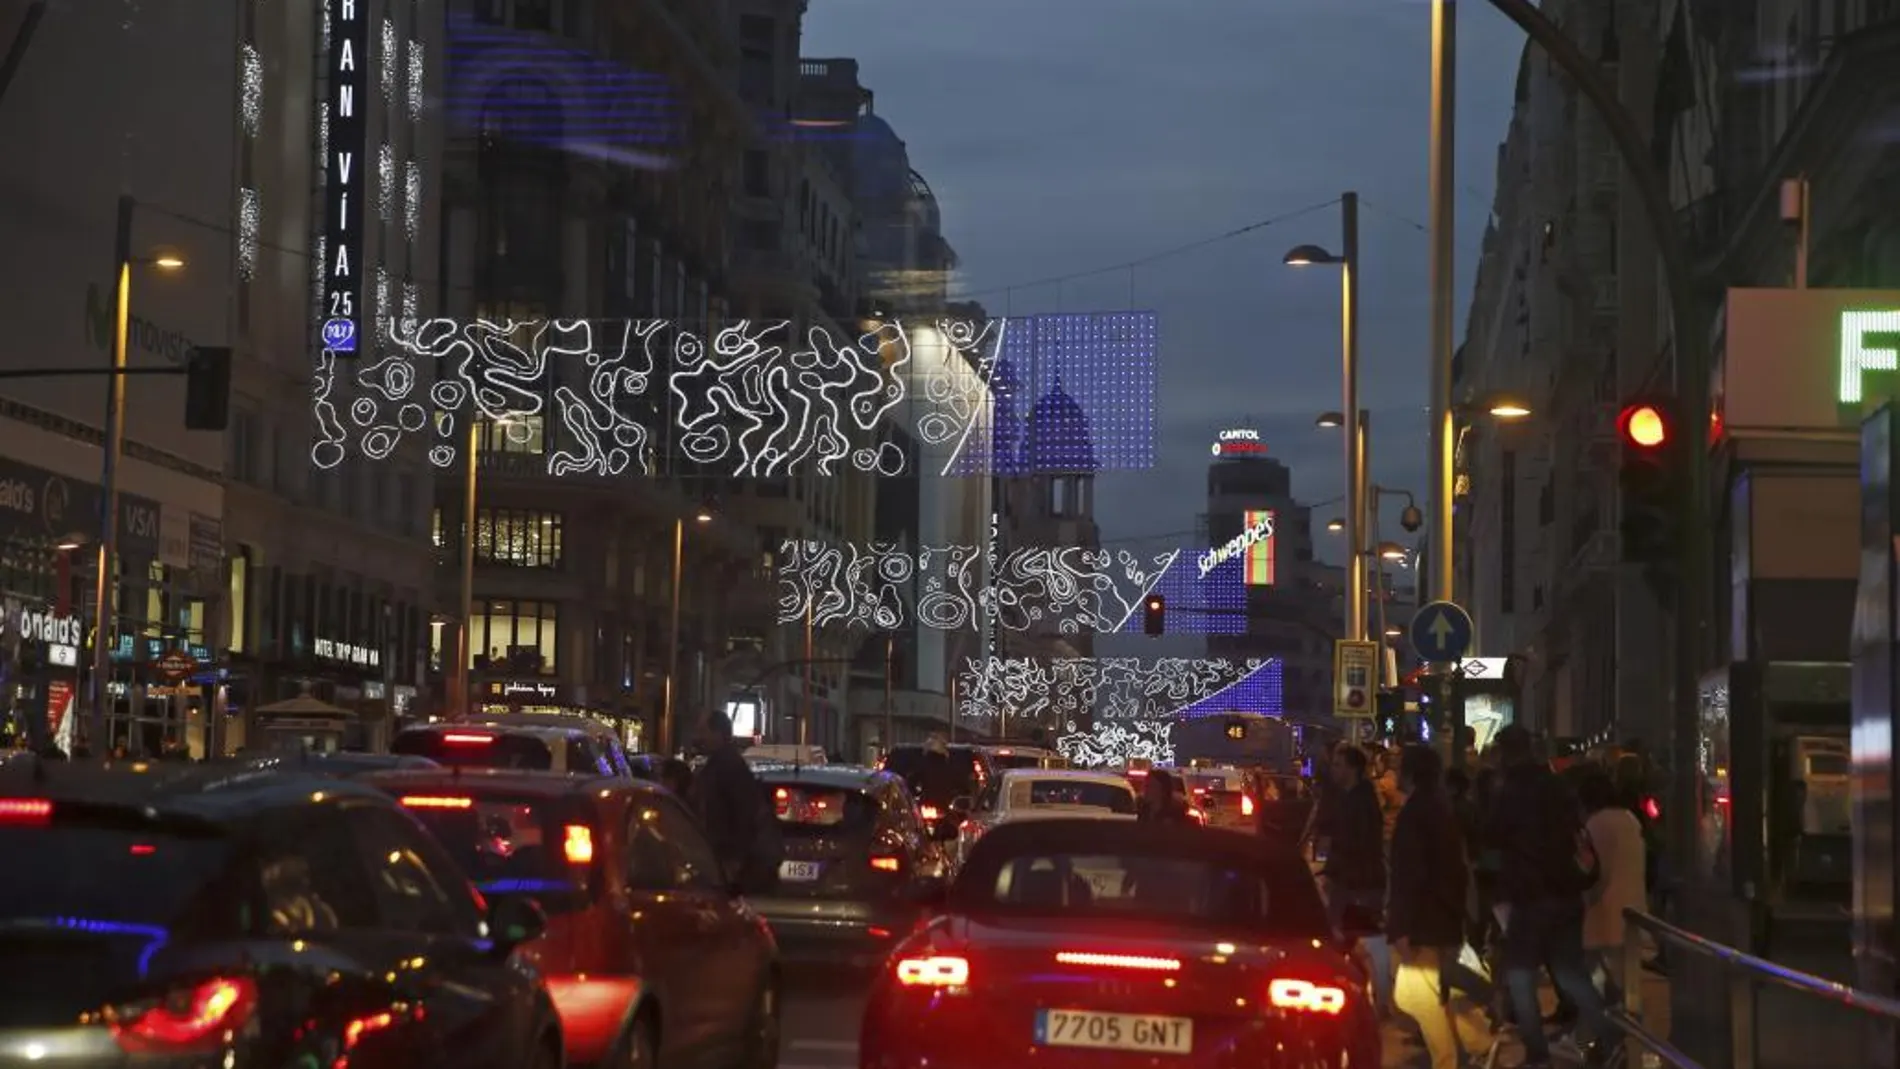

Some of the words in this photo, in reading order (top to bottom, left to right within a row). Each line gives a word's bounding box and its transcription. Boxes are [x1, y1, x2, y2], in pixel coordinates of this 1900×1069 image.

[331, 290, 352, 316] 25
[1197, 517, 1275, 580] Schweppes
[1053, 1013, 1121, 1042] 7705
[1132, 1019, 1185, 1047] GNT
